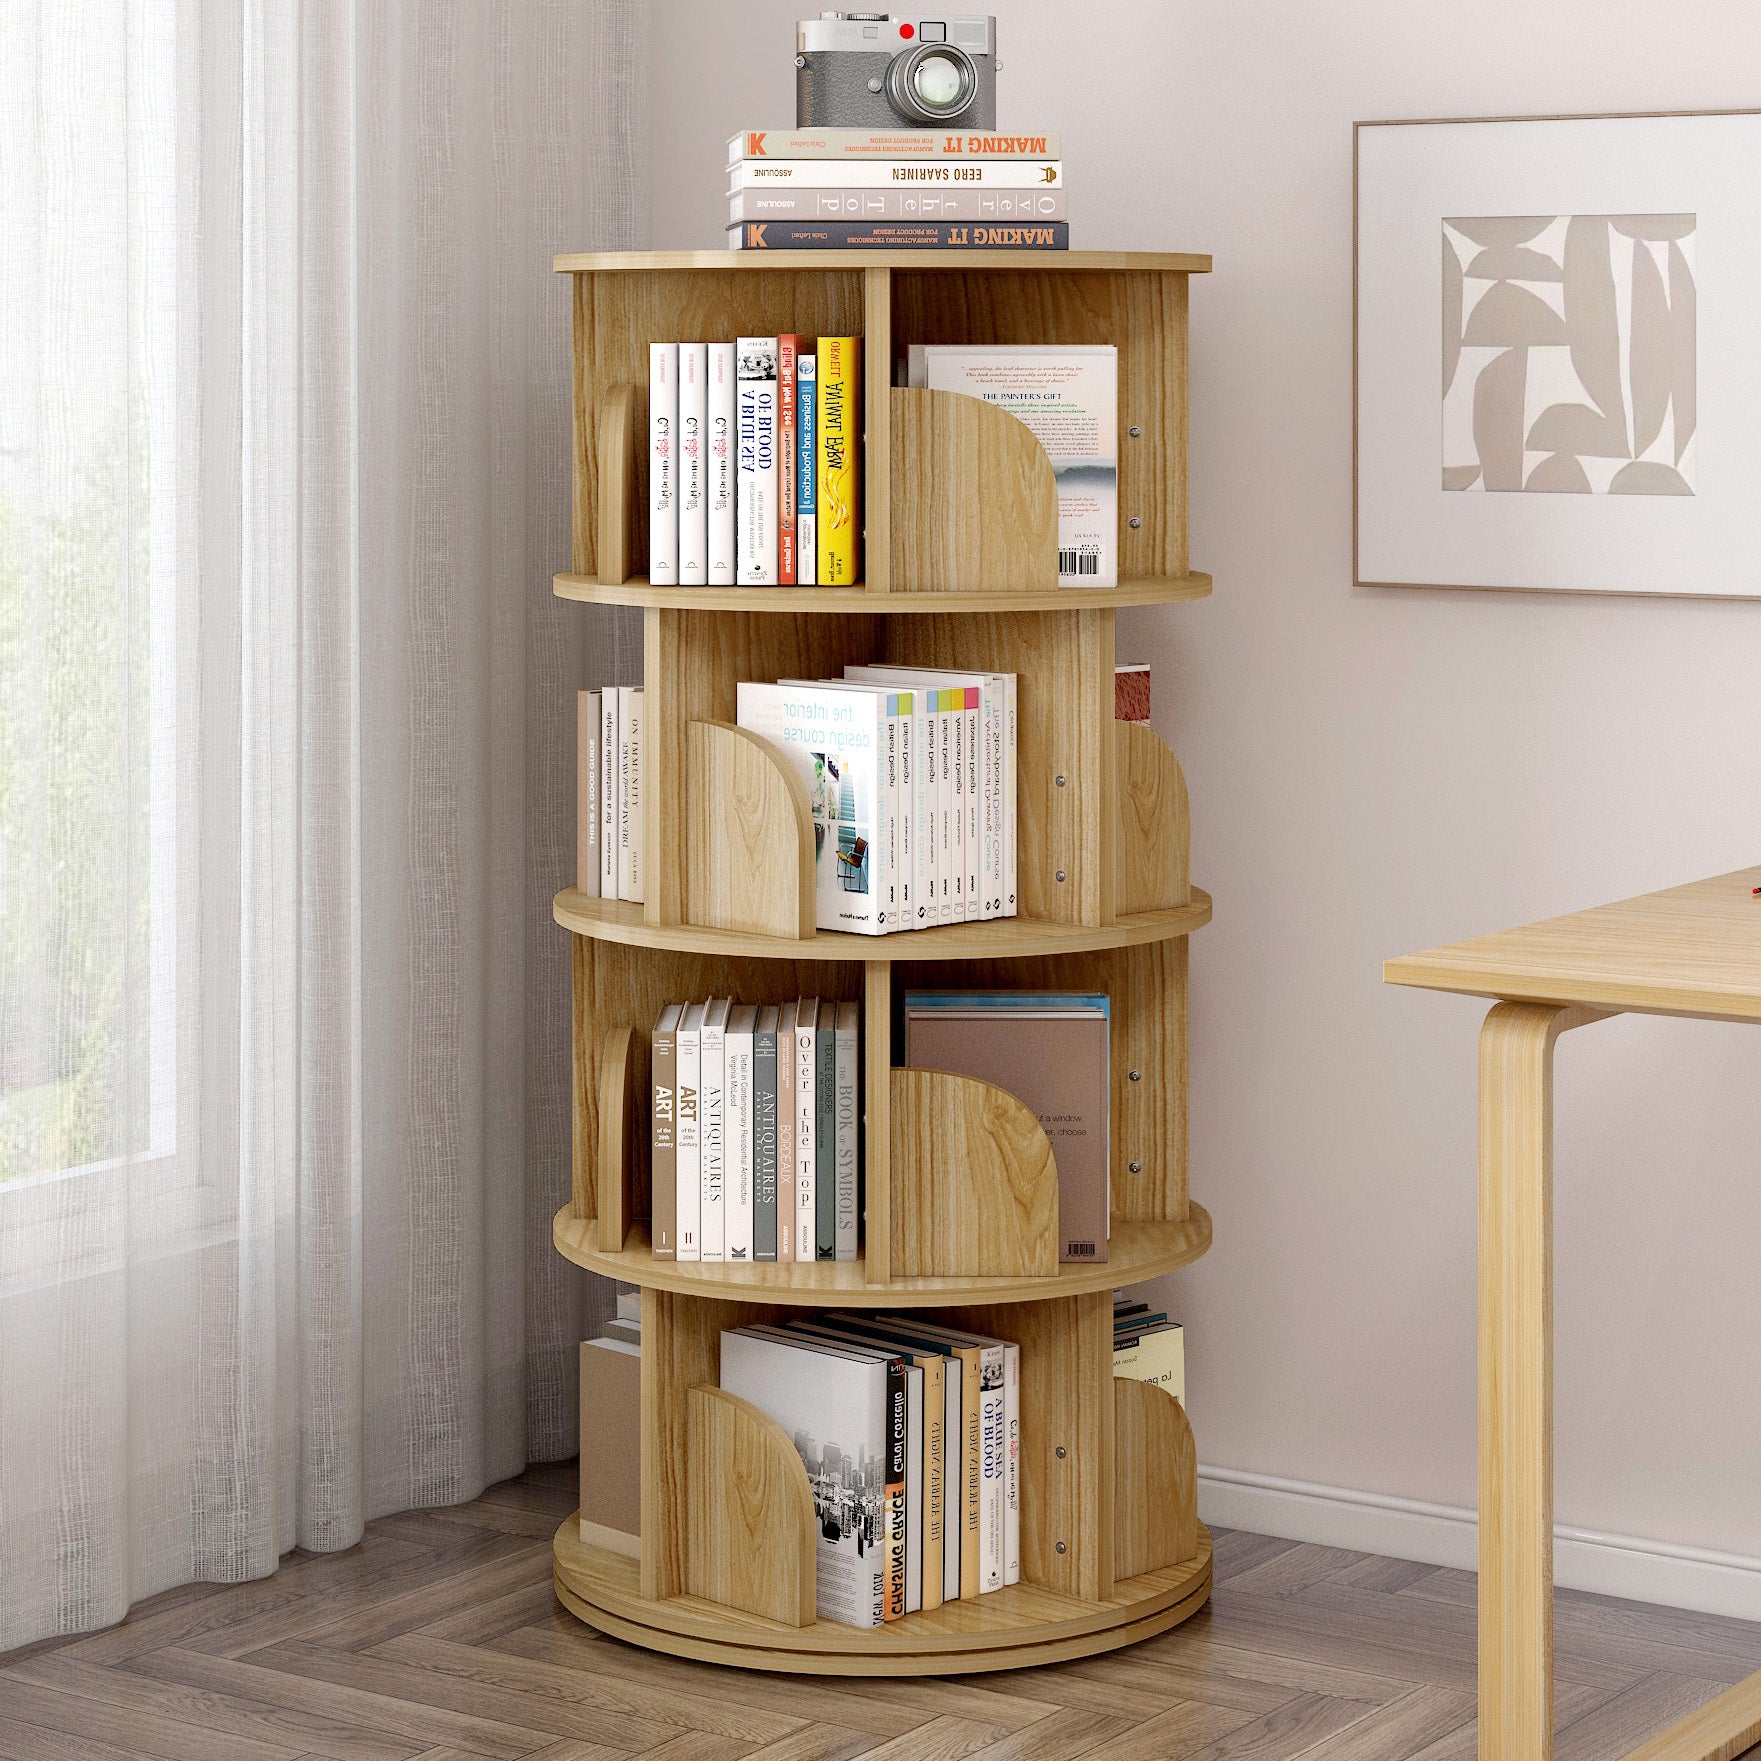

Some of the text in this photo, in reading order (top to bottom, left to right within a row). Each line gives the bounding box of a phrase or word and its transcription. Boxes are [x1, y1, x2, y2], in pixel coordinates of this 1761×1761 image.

[943, 137, 1047, 154] MAKING IT
[754, 169, 793, 177] ASSOULINE
[892, 168, 982, 181] EERO SAARINEN
[757, 200, 796, 208] ASSOULINE
[904, 198, 958, 211] the
[983, 197, 1056, 214] Over
[811, 232, 828, 240] Chris
[948, 228, 1054, 245] MAKING IT
[632, 719, 639, 735] ON
[589, 803, 595, 811] A
[589, 812, 595, 822] IS
[740, 1054, 748, 1073] Detail
[799, 1036, 811, 1089] Over
[729, 1055, 738, 1107] Virginia McLeod
[824, 1043, 833, 1114] TEXTILE DESIGNERS
[655, 1085, 673, 1122] ART
[680, 1086, 697, 1121] ART
[738, 1082, 747, 1128] Contemporary
[839, 1085, 853, 1131] BOOK
[801, 1107, 809, 1146] the
[1052, 1113, 1082, 1123] window
[839, 1135, 846, 1145] OF
[1057, 1127, 1087, 1136] choose
[654, 1141, 674, 1149] Century
[679, 1141, 698, 1149] Century
[708, 1086, 722, 1202] ANTIQUAIRES
[762, 1091, 775, 1204] ANTIQUAIRES
[780, 1124, 792, 1184] BORDEAUX
[839, 1149, 853, 1231] SYMBOLS
[783, 1225, 791, 1254] ASSOULINE
[995, 1398, 1003, 1408] A
[984, 1403, 994, 1478] OF BLOOD
[995, 1411, 1003, 1452] BLUE
[995, 1454, 1003, 1479] SEA
